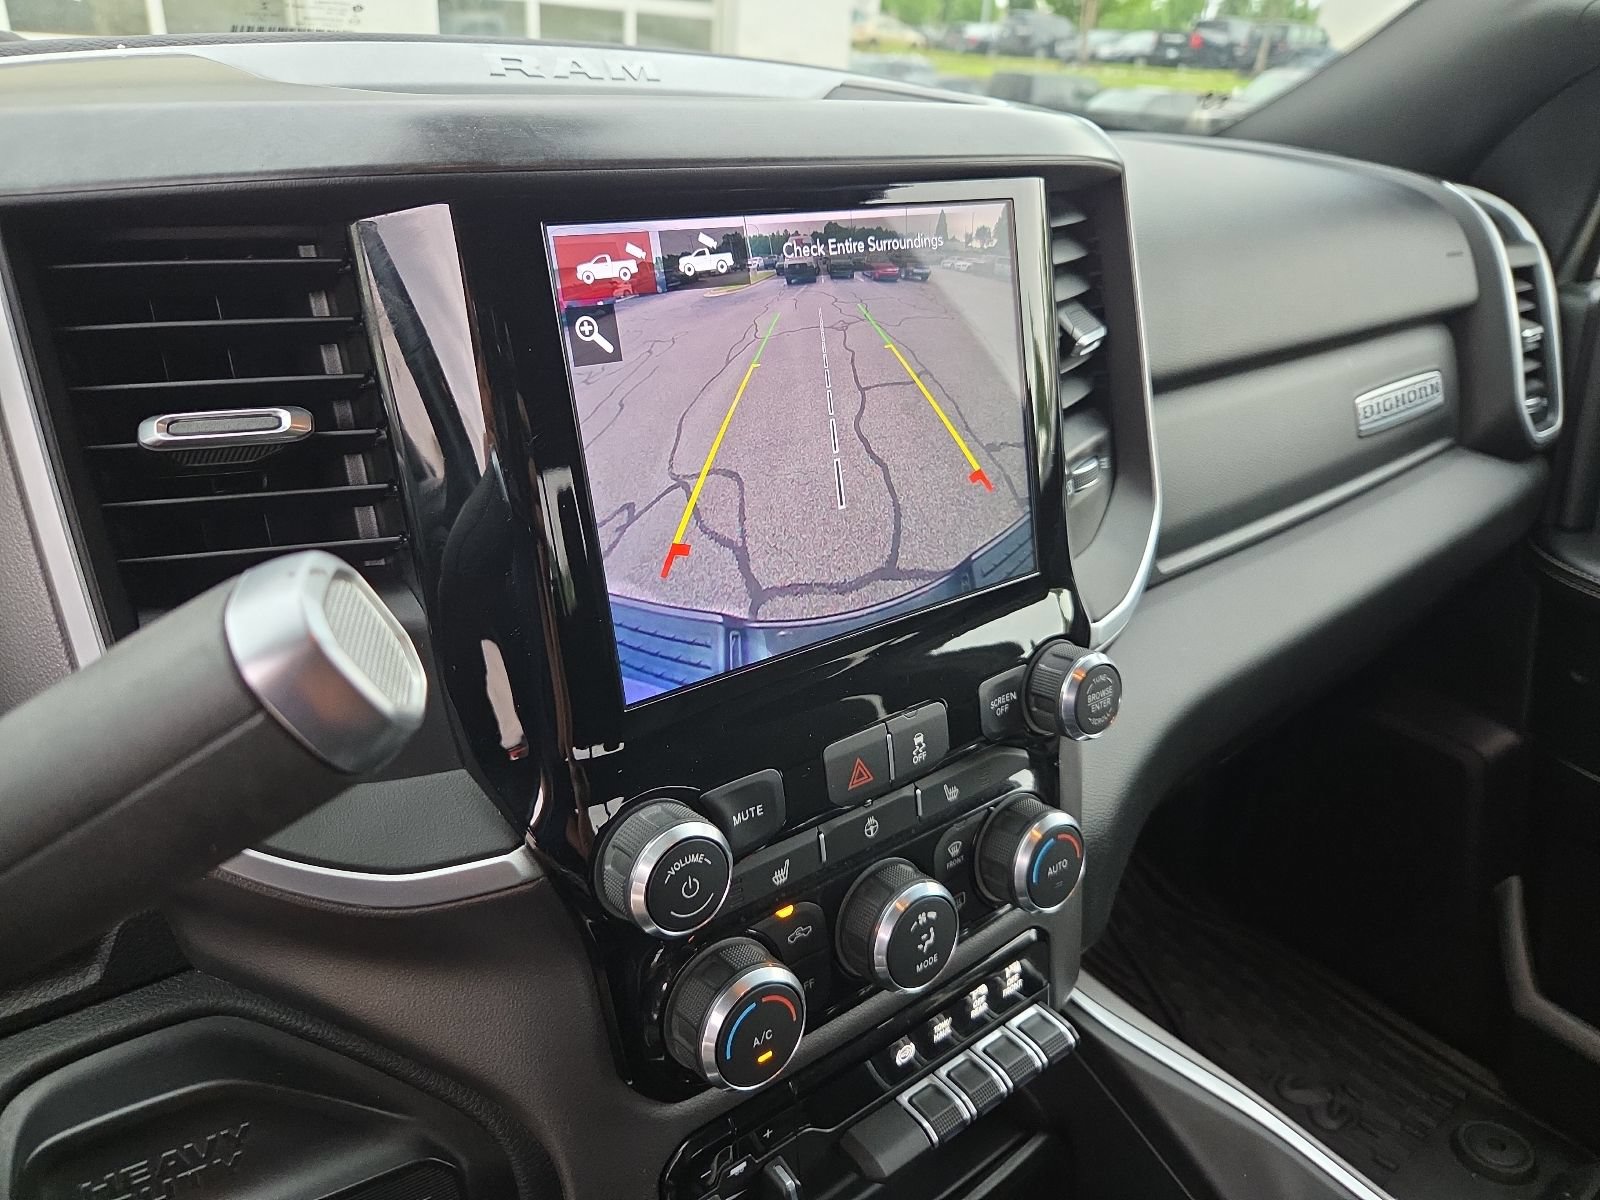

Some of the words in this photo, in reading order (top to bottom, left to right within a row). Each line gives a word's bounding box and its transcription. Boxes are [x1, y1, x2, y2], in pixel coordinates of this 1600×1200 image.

[486, 54, 661, 82] RAM
[782, 238, 825, 259] Check
[828, 237, 865, 256] Entire
[867, 232, 944, 252] Surroundings
[1362, 381, 1440, 420] BIGHORN
[990, 691, 1017, 710] SCREEN
[1087, 685, 1113, 704] BROWSE
[995, 703, 1009, 717] OFF
[1091, 697, 1111, 713] ENTER
[912, 750, 927, 765] OFF
[732, 805, 764, 826] MUTE
[667, 852, 705, 875] VOLUME
[946, 855, 964, 871] FRONT
[1047, 858, 1068, 878] AUTO
[916, 952, 938, 973] MODE
[803, 977, 815, 991] FF
[973, 994, 987, 1009] OFF
[752, 1029, 773, 1048] A/C
[78, 1122, 250, 1200] HEAVY
